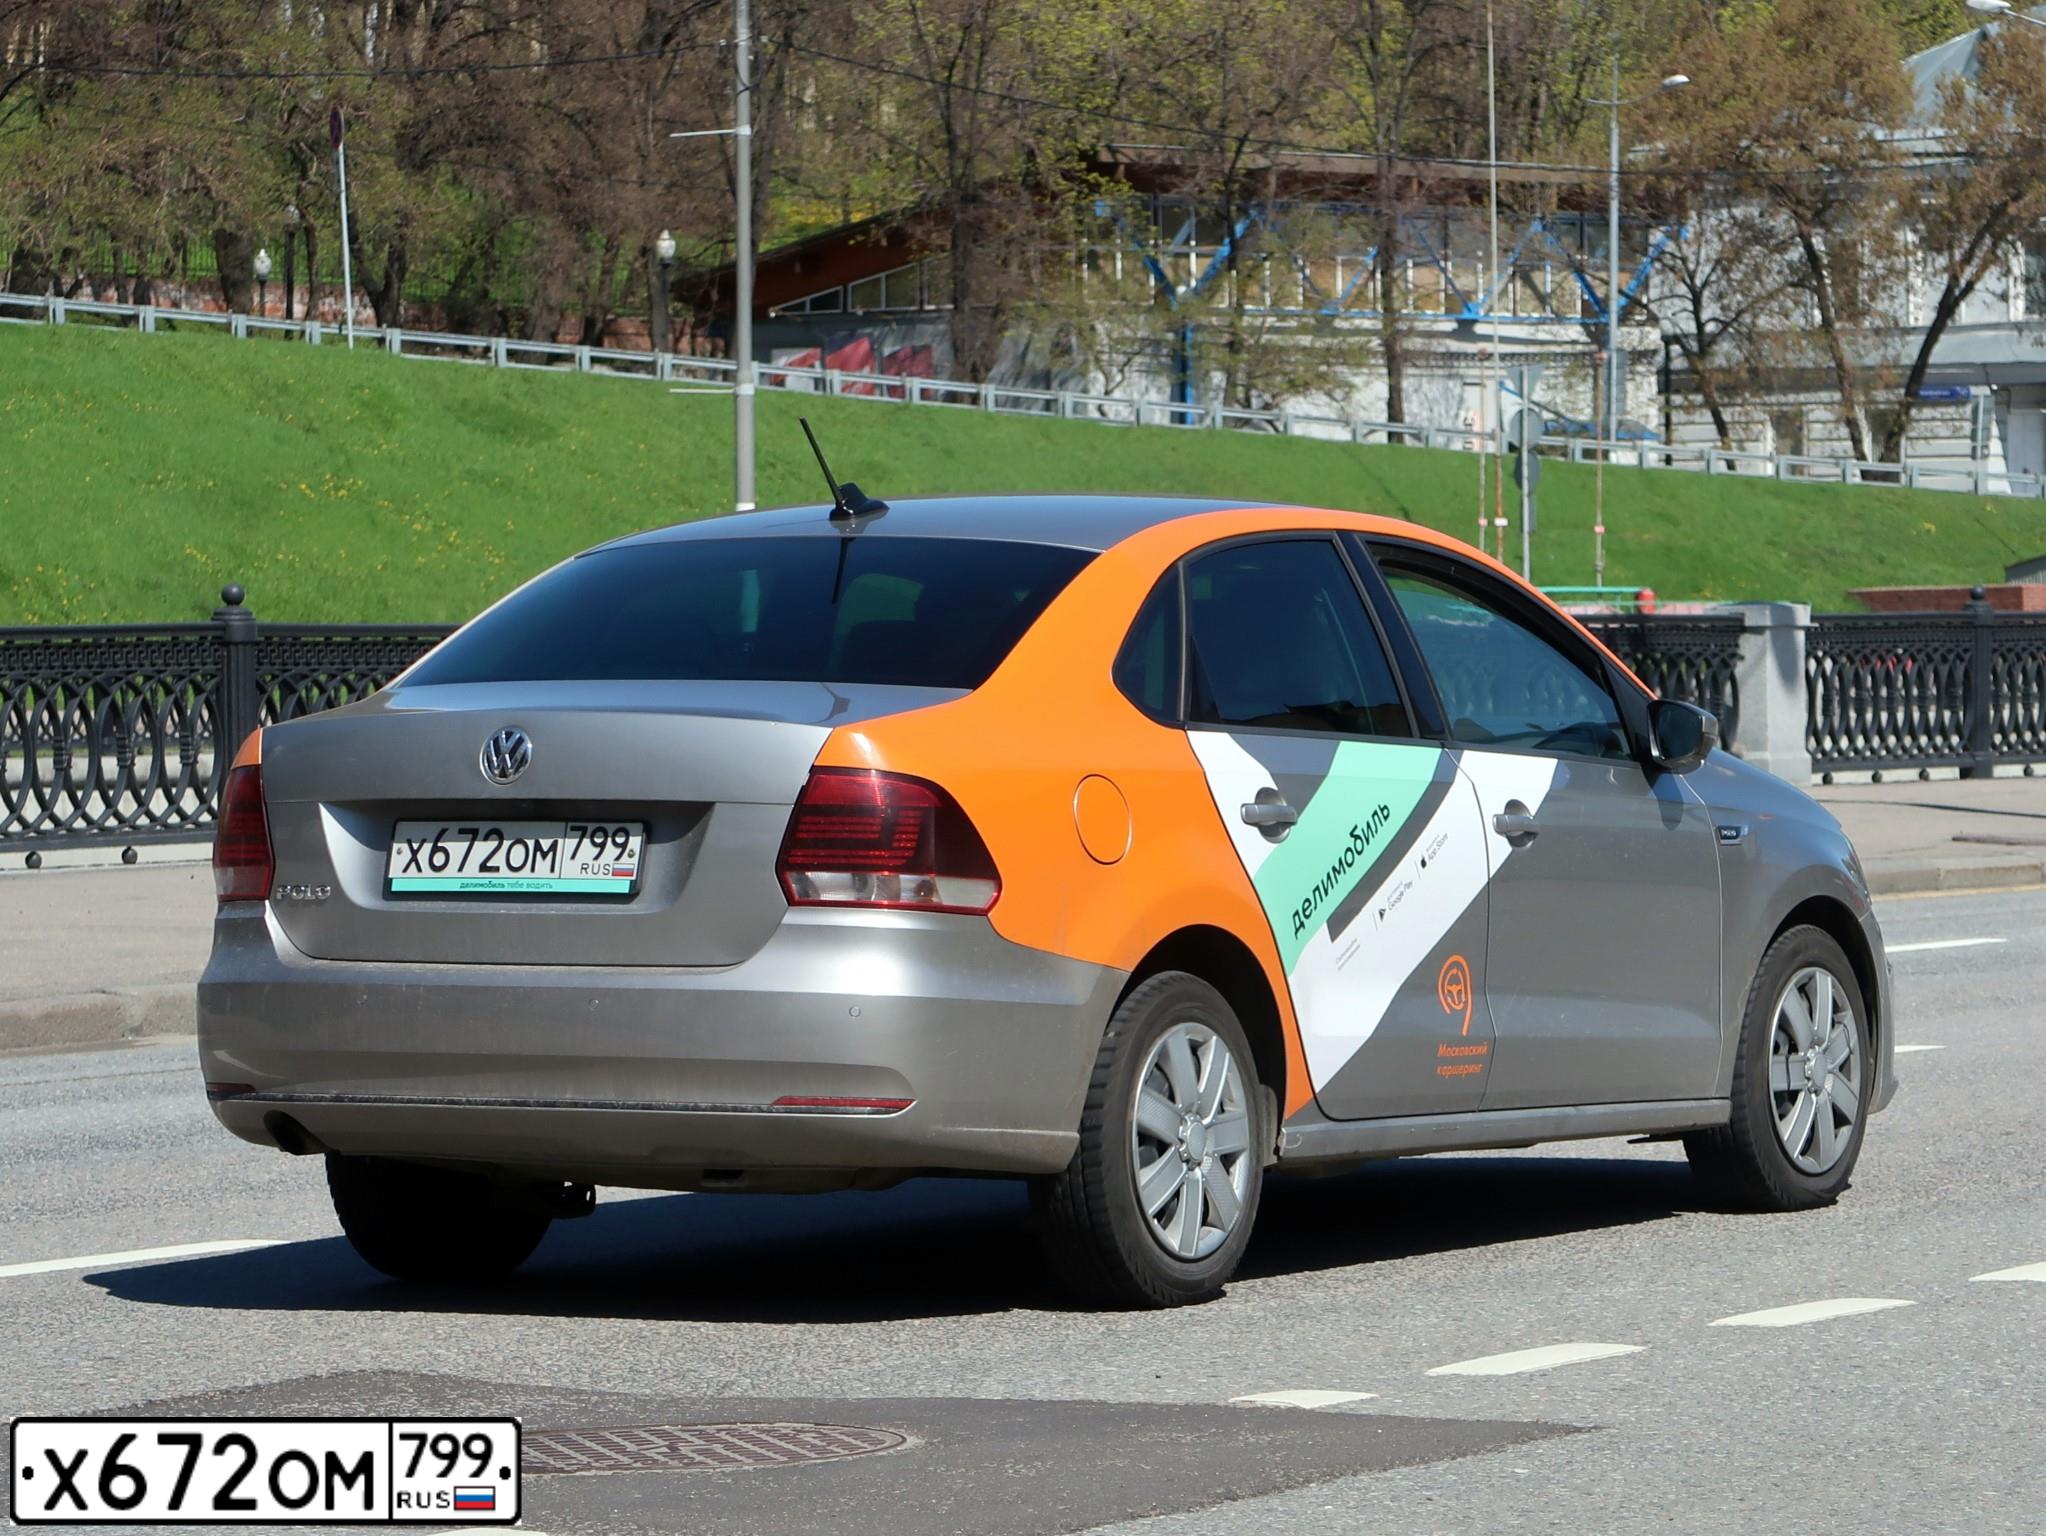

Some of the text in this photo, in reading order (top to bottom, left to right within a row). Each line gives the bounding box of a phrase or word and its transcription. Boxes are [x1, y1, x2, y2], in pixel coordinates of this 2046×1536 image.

[569, 826, 630, 861] 799
[580, 862, 610, 876] RUS
[1291, 803, 1391, 941] делимобиль
[276, 884, 331, 900] POLO
[1437, 1041, 1489, 1057] Московский
